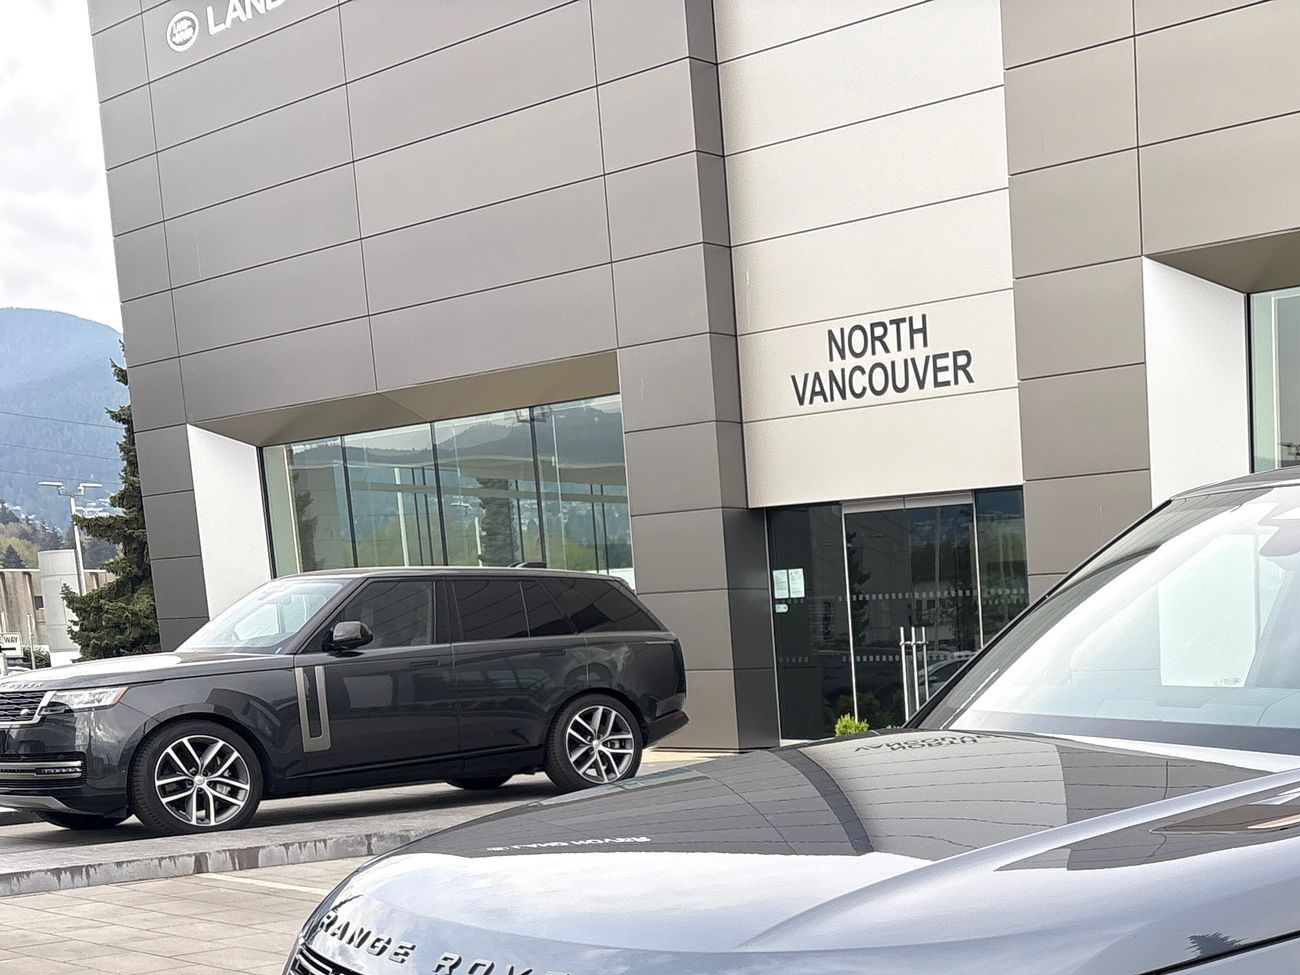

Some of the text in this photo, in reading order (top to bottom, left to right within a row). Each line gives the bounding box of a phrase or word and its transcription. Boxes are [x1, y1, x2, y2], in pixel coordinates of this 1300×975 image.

[827, 313, 928, 362] NORTH
[790, 349, 975, 406] VANCOUVER
[320, 910, 416, 964] RANGE
